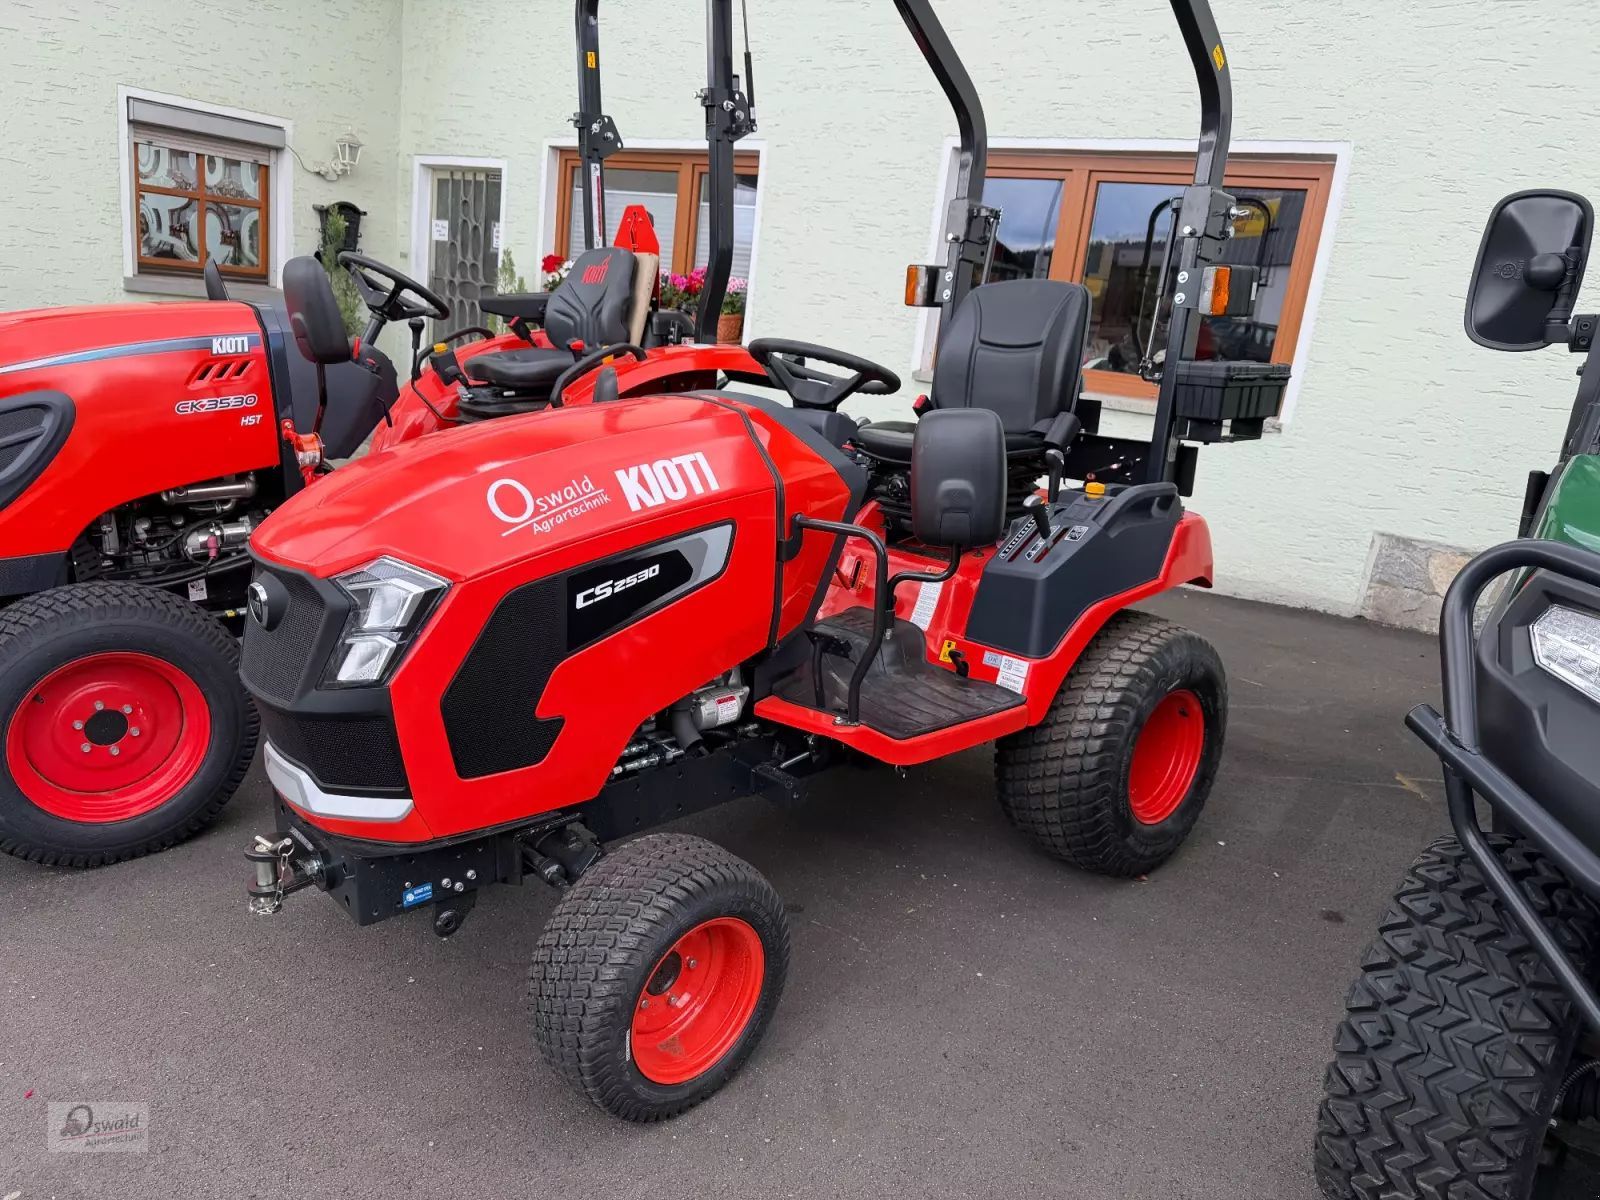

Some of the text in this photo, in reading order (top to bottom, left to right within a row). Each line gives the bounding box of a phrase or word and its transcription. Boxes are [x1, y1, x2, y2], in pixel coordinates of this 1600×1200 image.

[212, 336, 249, 354] KIOTI
[175, 394, 258, 414] CK3530
[240, 414, 263, 426] HST
[614, 451, 721, 512] KIOTI
[487, 475, 596, 524] Oswald
[533, 491, 612, 536] Agrartechnik
